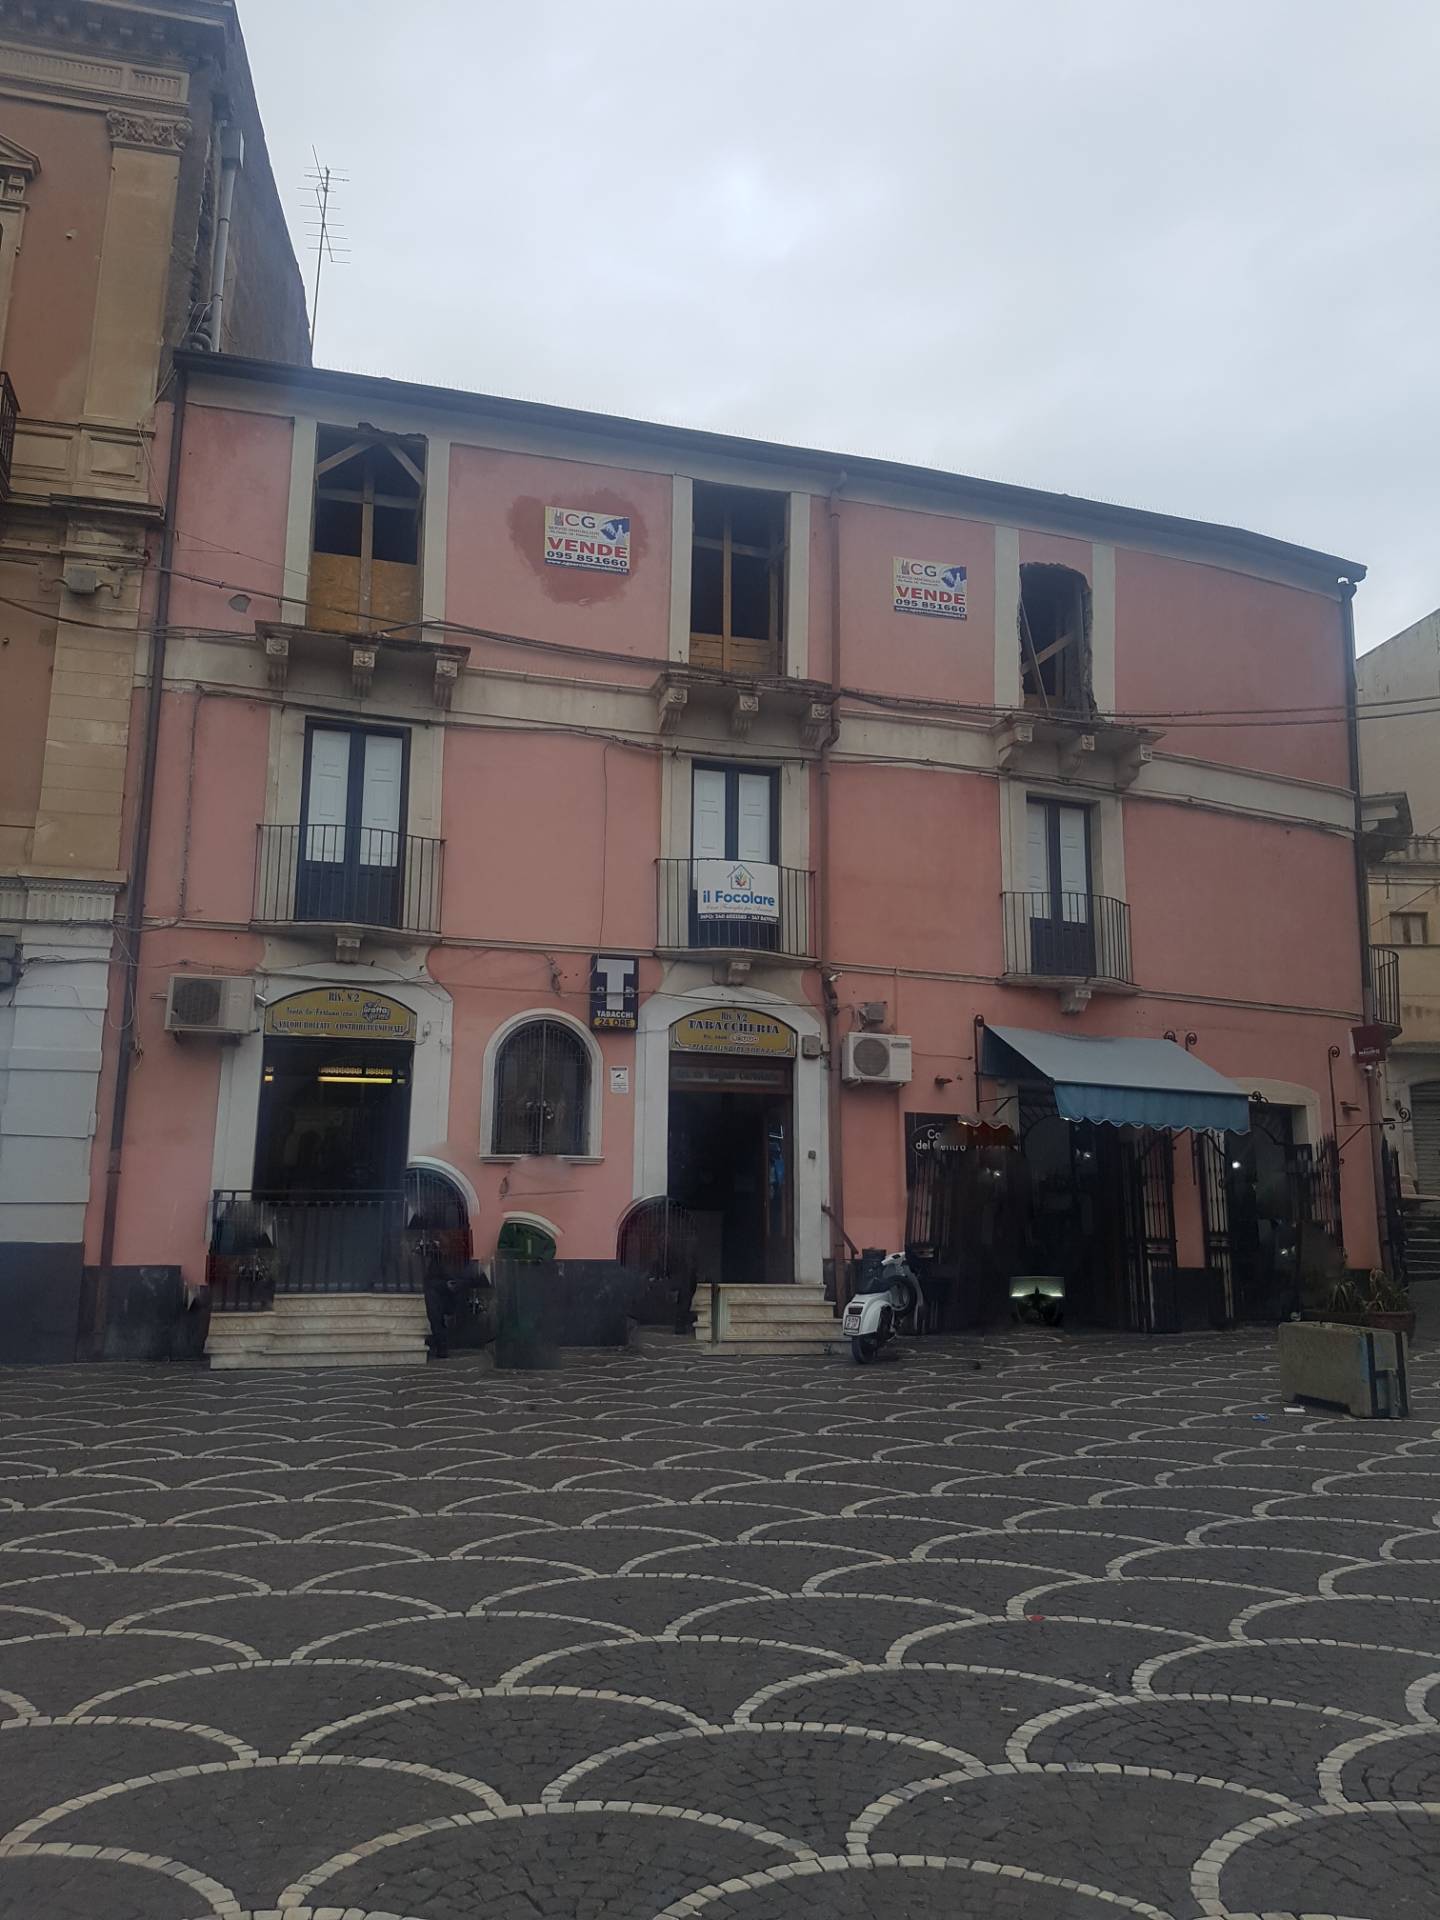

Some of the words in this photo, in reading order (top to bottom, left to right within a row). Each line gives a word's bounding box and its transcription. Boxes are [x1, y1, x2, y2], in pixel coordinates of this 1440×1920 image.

[547, 536, 628, 559] VENDE
[547, 550, 573, 560] 095
[576, 554, 628, 567] 851660
[896, 585, 965, 605] VENDE
[896, 599, 918, 607] 095
[922, 602, 966, 613] 851660
[703, 890, 710, 903] il
[715, 891, 775, 906] Focolare
[597, 1010, 634, 1018] TABACCHI
[599, 1018, 610, 1027] 24
[613, 1018, 633, 1027] ORE
[688, 1020, 780, 1034] TABACCHERIA
[915, 1140, 931, 1150] del
